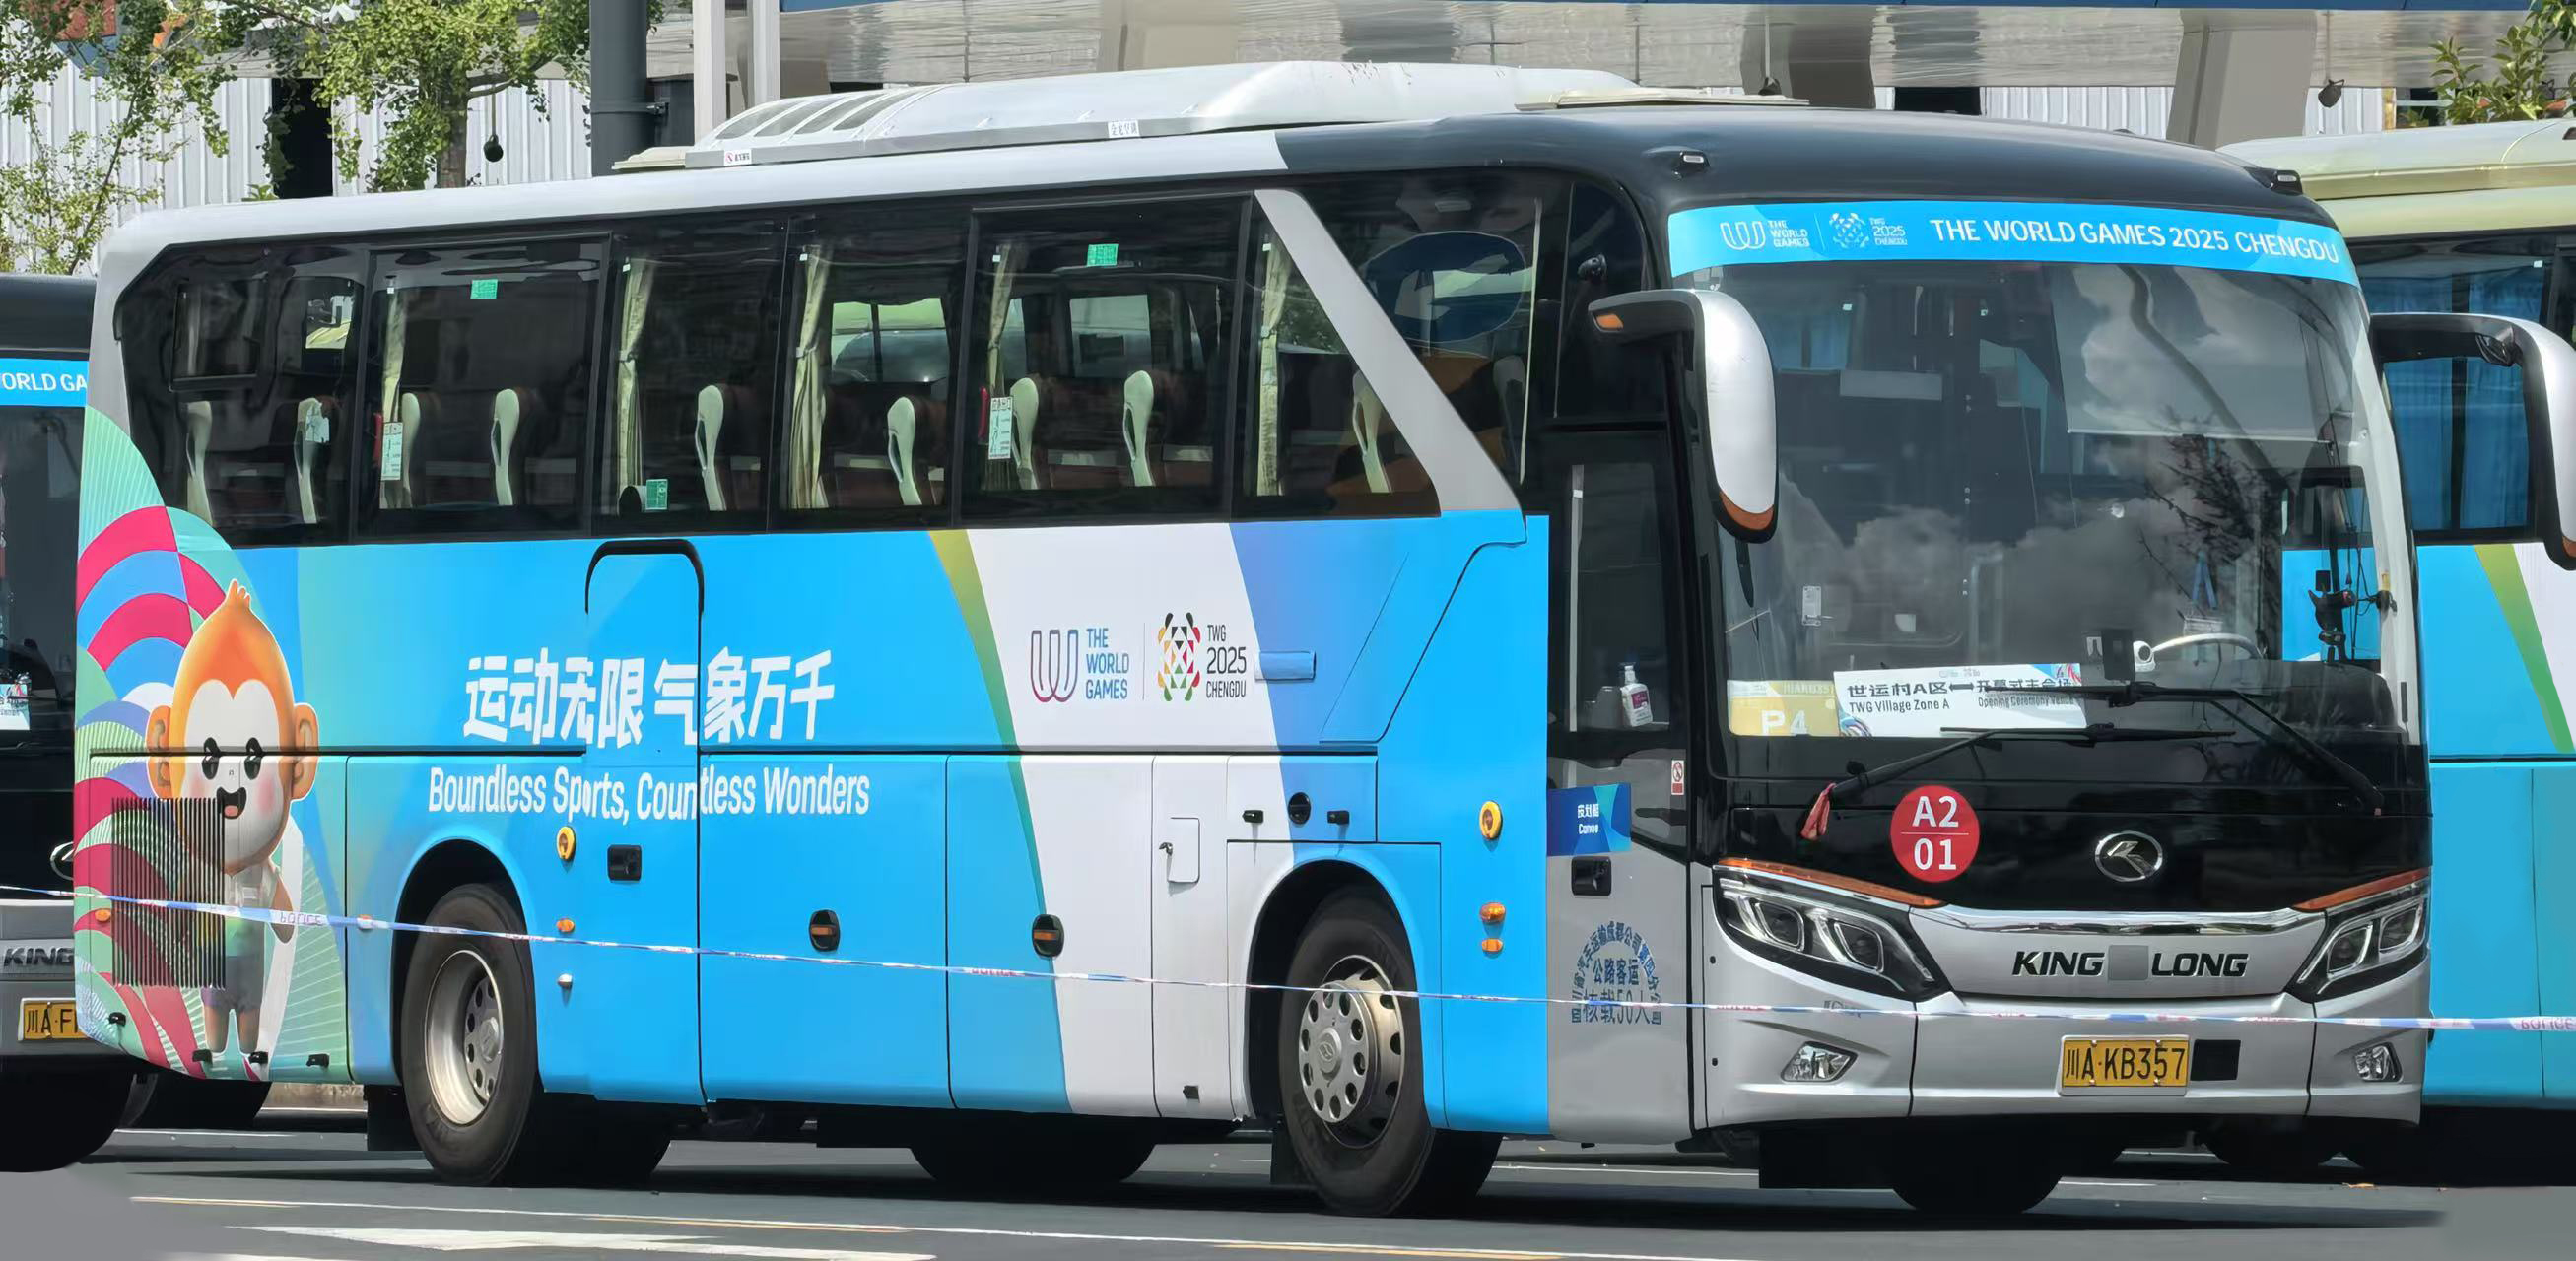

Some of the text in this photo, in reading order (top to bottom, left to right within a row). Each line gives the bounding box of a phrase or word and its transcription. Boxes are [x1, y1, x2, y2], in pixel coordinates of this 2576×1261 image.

[1771, 229, 1809, 238] WORLD
[1872, 226, 1906, 237] 2025
[1930, 219, 2339, 264] THE WORLD GAMES 2025 CHENGDU
[1773, 238, 1811, 248] GAMES
[0, 372, 57, 391] ORLD
[1086, 628, 1109, 649] THE
[1207, 624, 1227, 642] TWG
[1086, 652, 1130, 675] WORLD
[1206, 646, 1247, 675] 2025
[463, 645, 836, 750] 运动无限 气象万千
[1085, 678, 1128, 700] GAMES
[1205, 680, 1247, 699] CHENGDU
[1847, 681, 1949, 698] 世运村A区
[1849, 697, 1950, 714] TWG Village Zone A
[1978, 696, 2010, 708] Opening
[1761, 708, 1808, 737] P4
[428, 763, 870, 827] Boundless Sports, Countless Wonders
[1912, 795, 1959, 828] A2
[1578, 823, 1599, 835] Canoe
[1914, 837, 1957, 871] 01
[1593, 957, 1640, 985] 公路客运
[2012, 951, 2250, 977] KING LONG
[1583, 988, 1651, 1025] 核载50人
[27, 1008, 79, 1034] 川A·F
